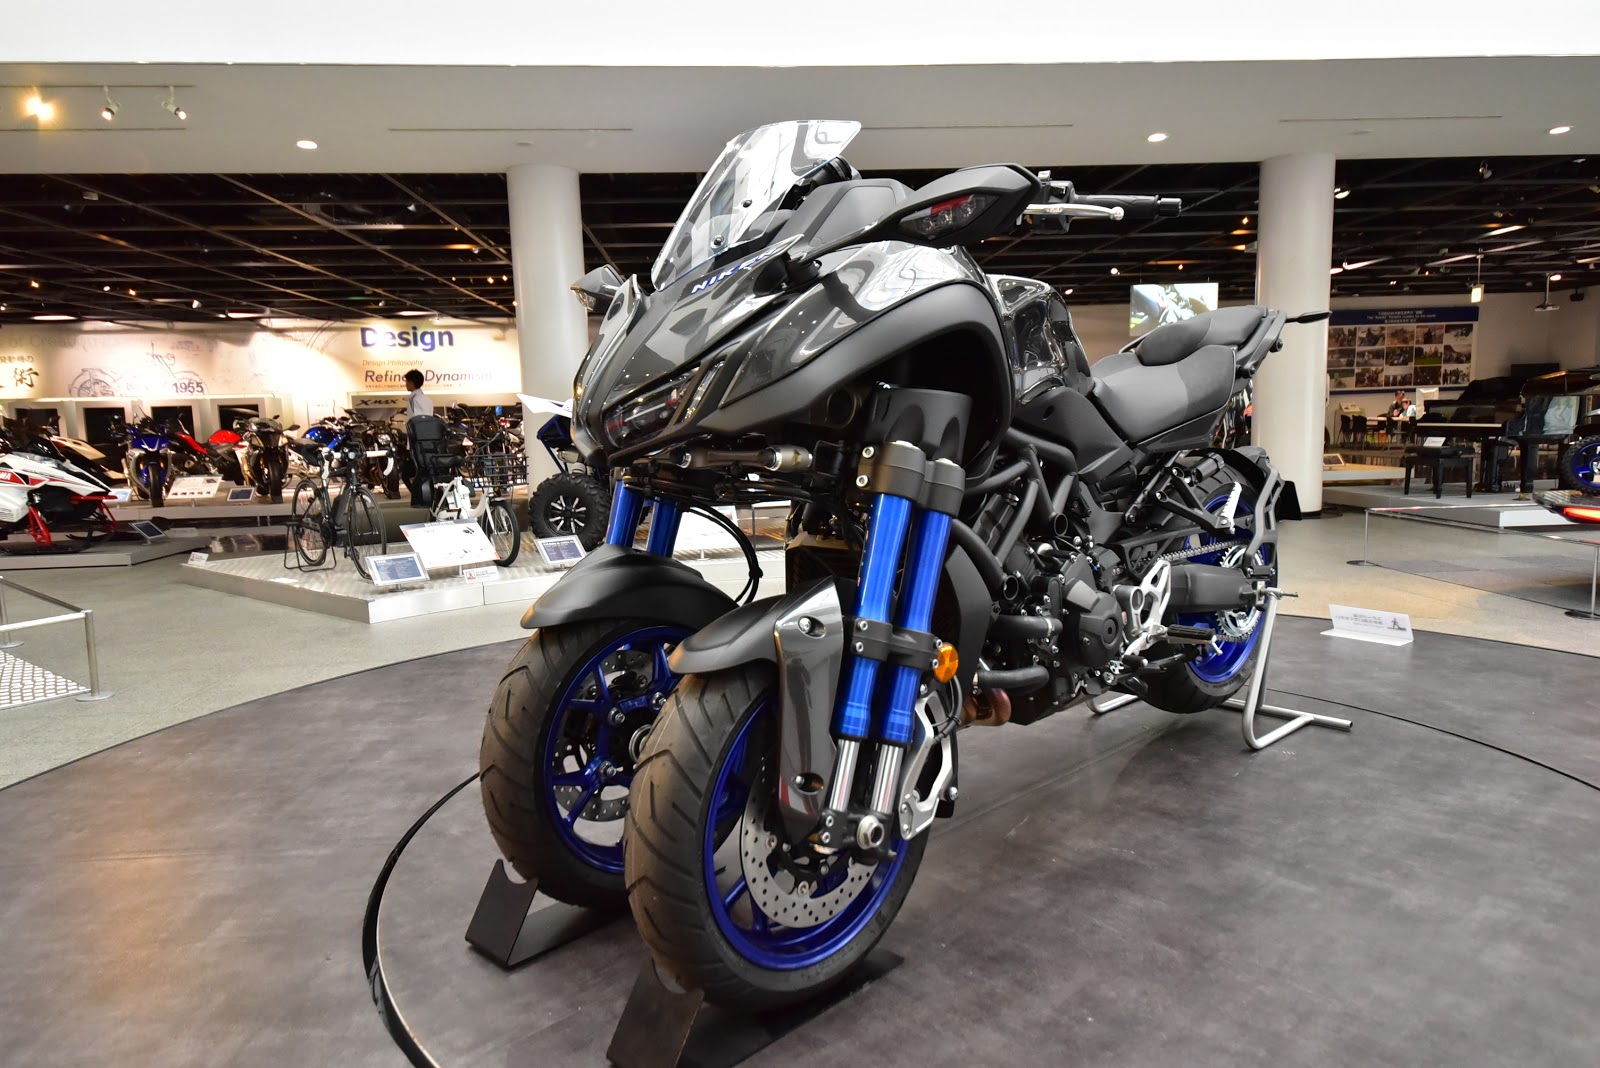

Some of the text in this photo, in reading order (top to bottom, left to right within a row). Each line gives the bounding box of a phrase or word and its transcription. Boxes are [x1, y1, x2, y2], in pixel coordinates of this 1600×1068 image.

[691, 248, 780, 294] NIKEN
[360, 326, 454, 352] Design
[362, 359, 424, 367] Design Philosophy
[364, 369, 407, 383] Refine
[172, 381, 204, 394] 1955
